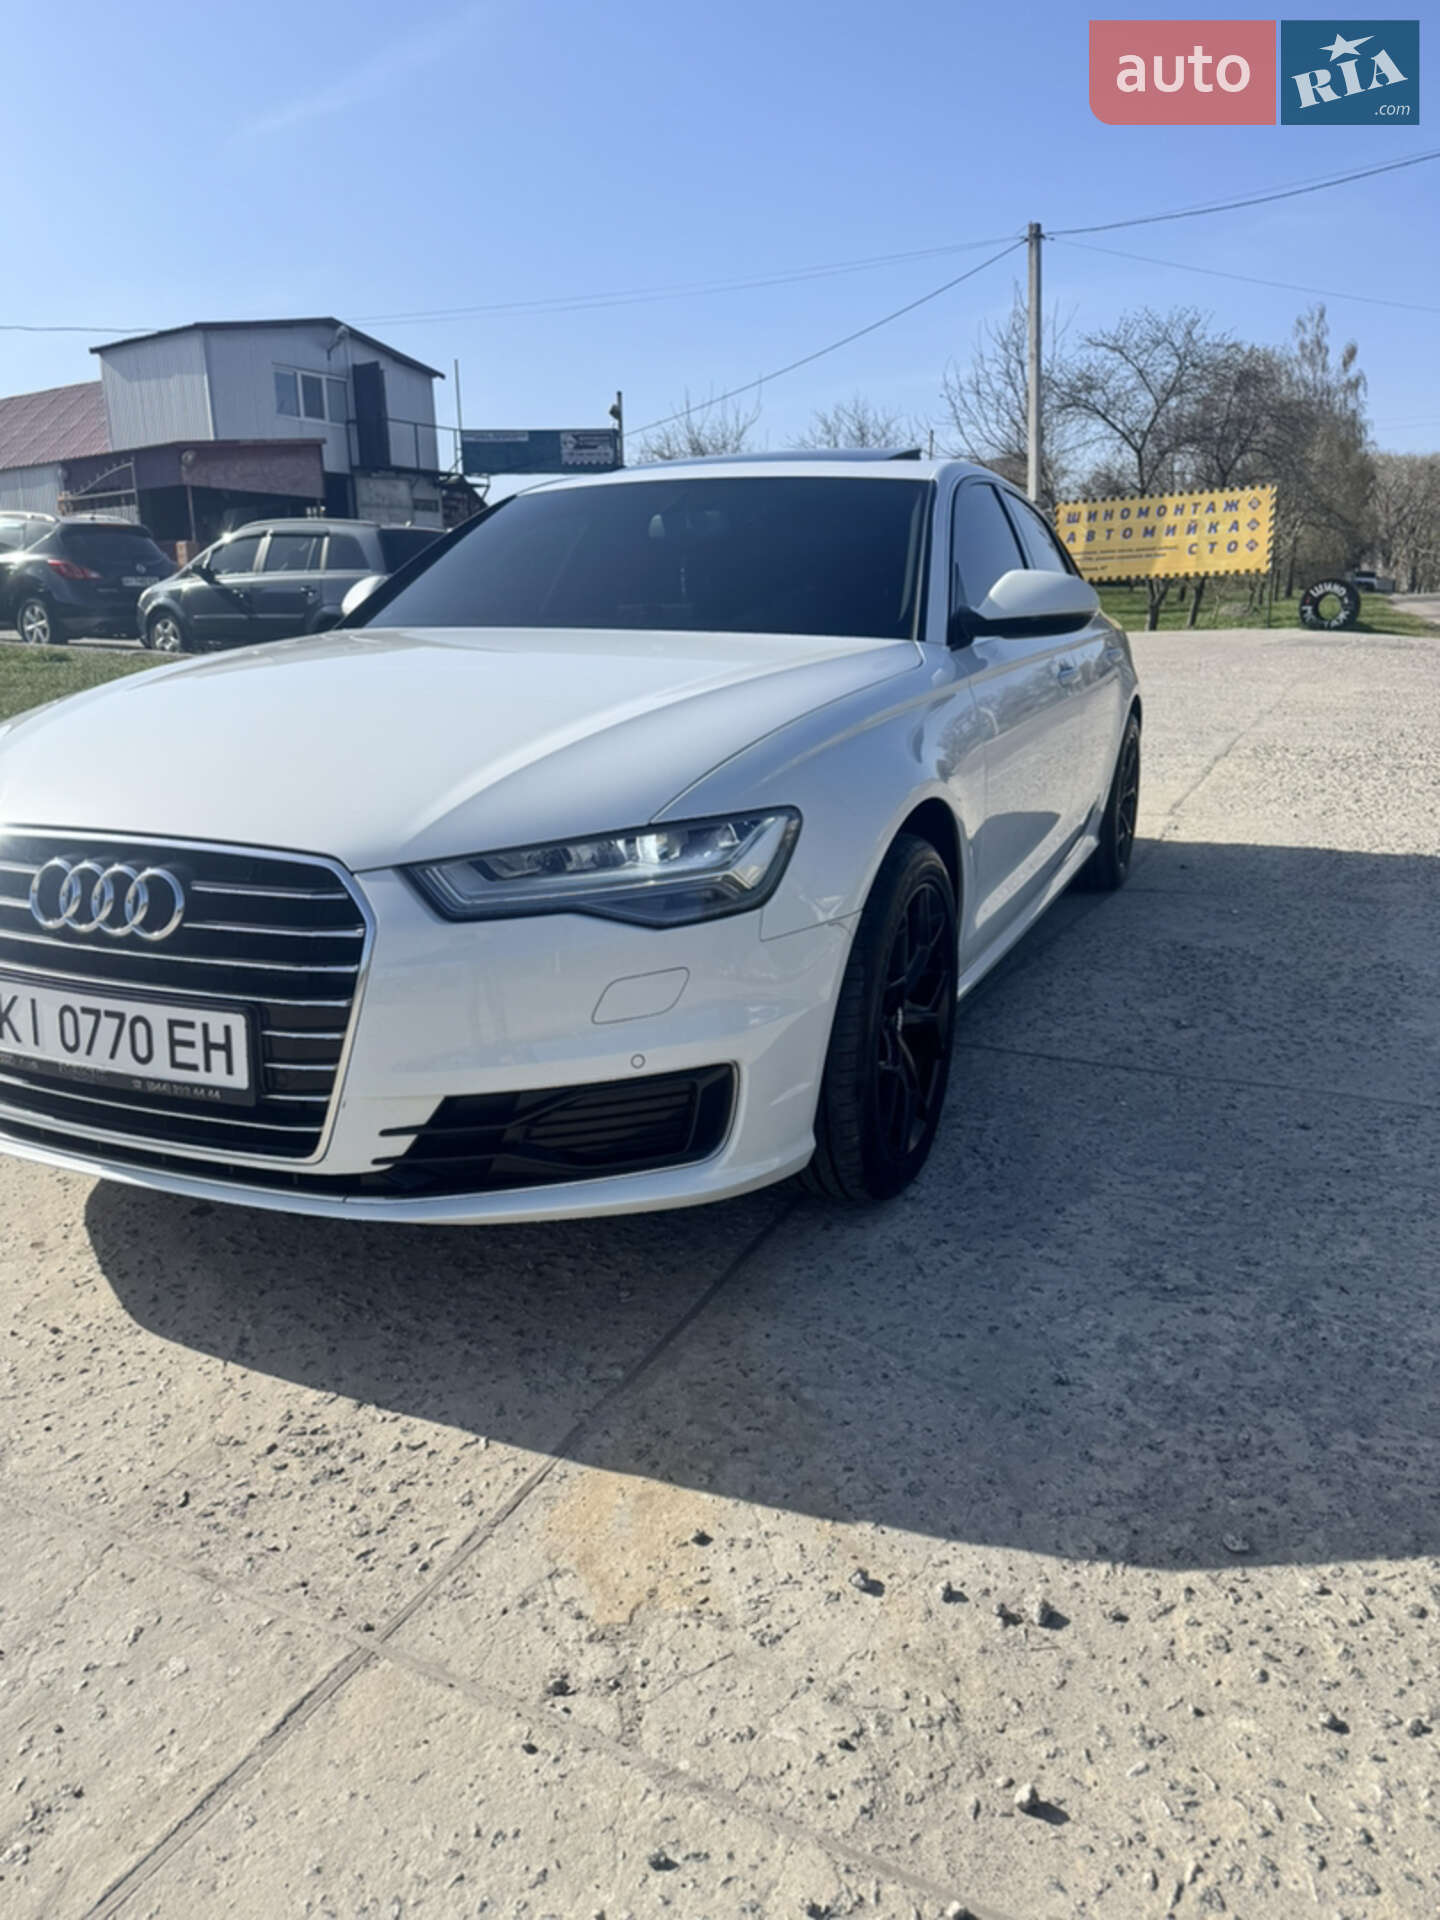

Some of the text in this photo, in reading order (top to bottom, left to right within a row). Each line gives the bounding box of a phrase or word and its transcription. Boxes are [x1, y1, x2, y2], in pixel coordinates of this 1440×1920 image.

[1066, 500, 1240, 524] ШИНОМОНТАЖ
[1066, 520, 1239, 543] АВТОМИЙКА
[1188, 540, 1239, 555] СТО
[58, 1004, 155, 1065] 0770
[167, 1018, 235, 1076] EH
